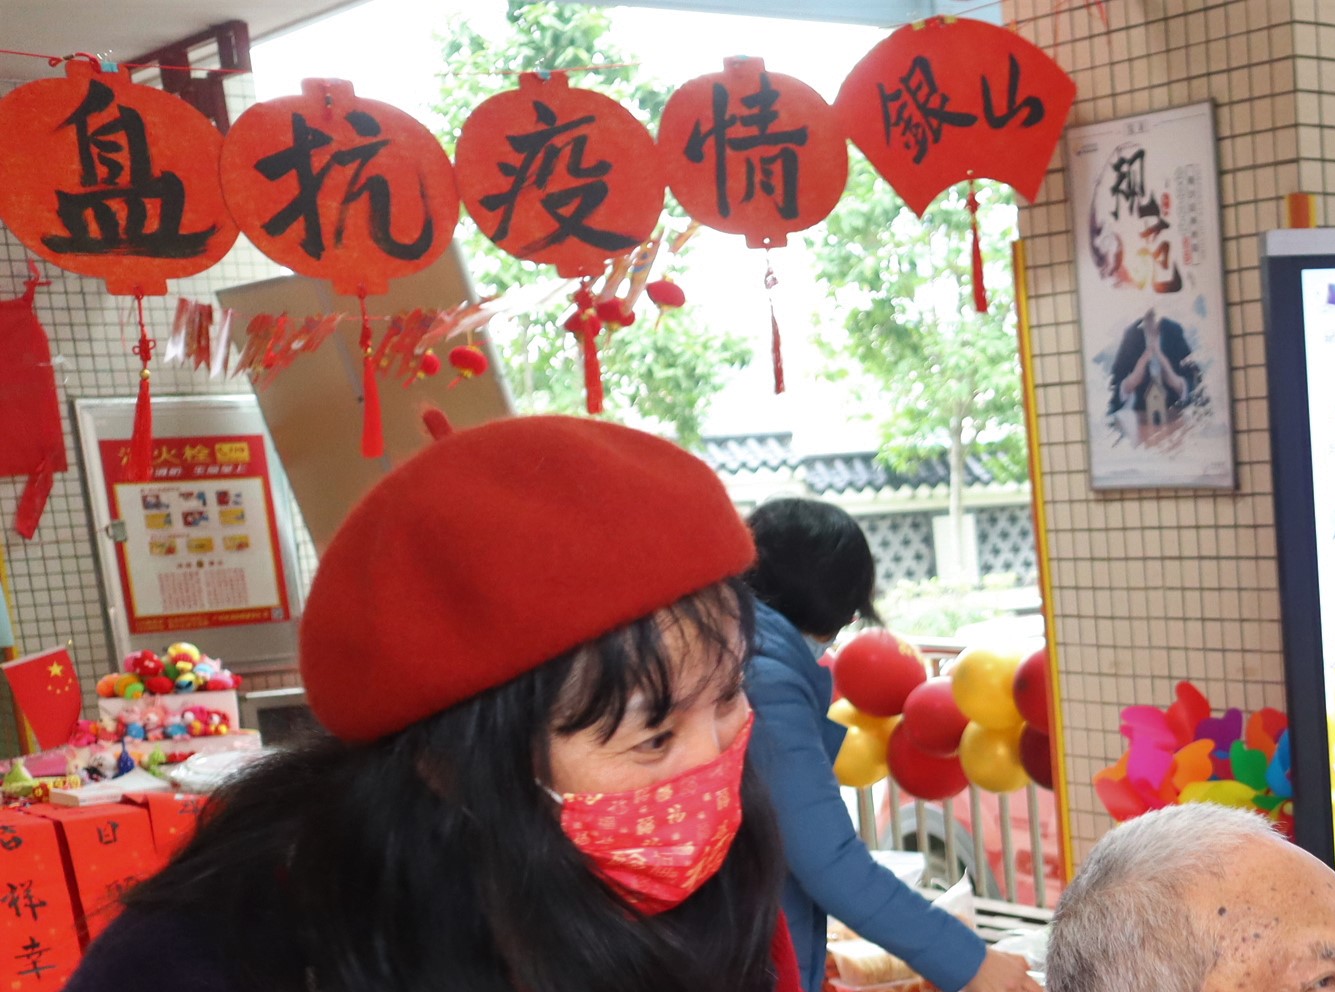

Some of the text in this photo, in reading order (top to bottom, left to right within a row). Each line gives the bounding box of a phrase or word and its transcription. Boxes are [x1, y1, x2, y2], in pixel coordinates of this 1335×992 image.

[479, 100, 642, 258] 疫
[683, 71, 807, 220] 情
[877, 53, 1045, 165] 銀山
[254, 111, 433, 261] 抗
